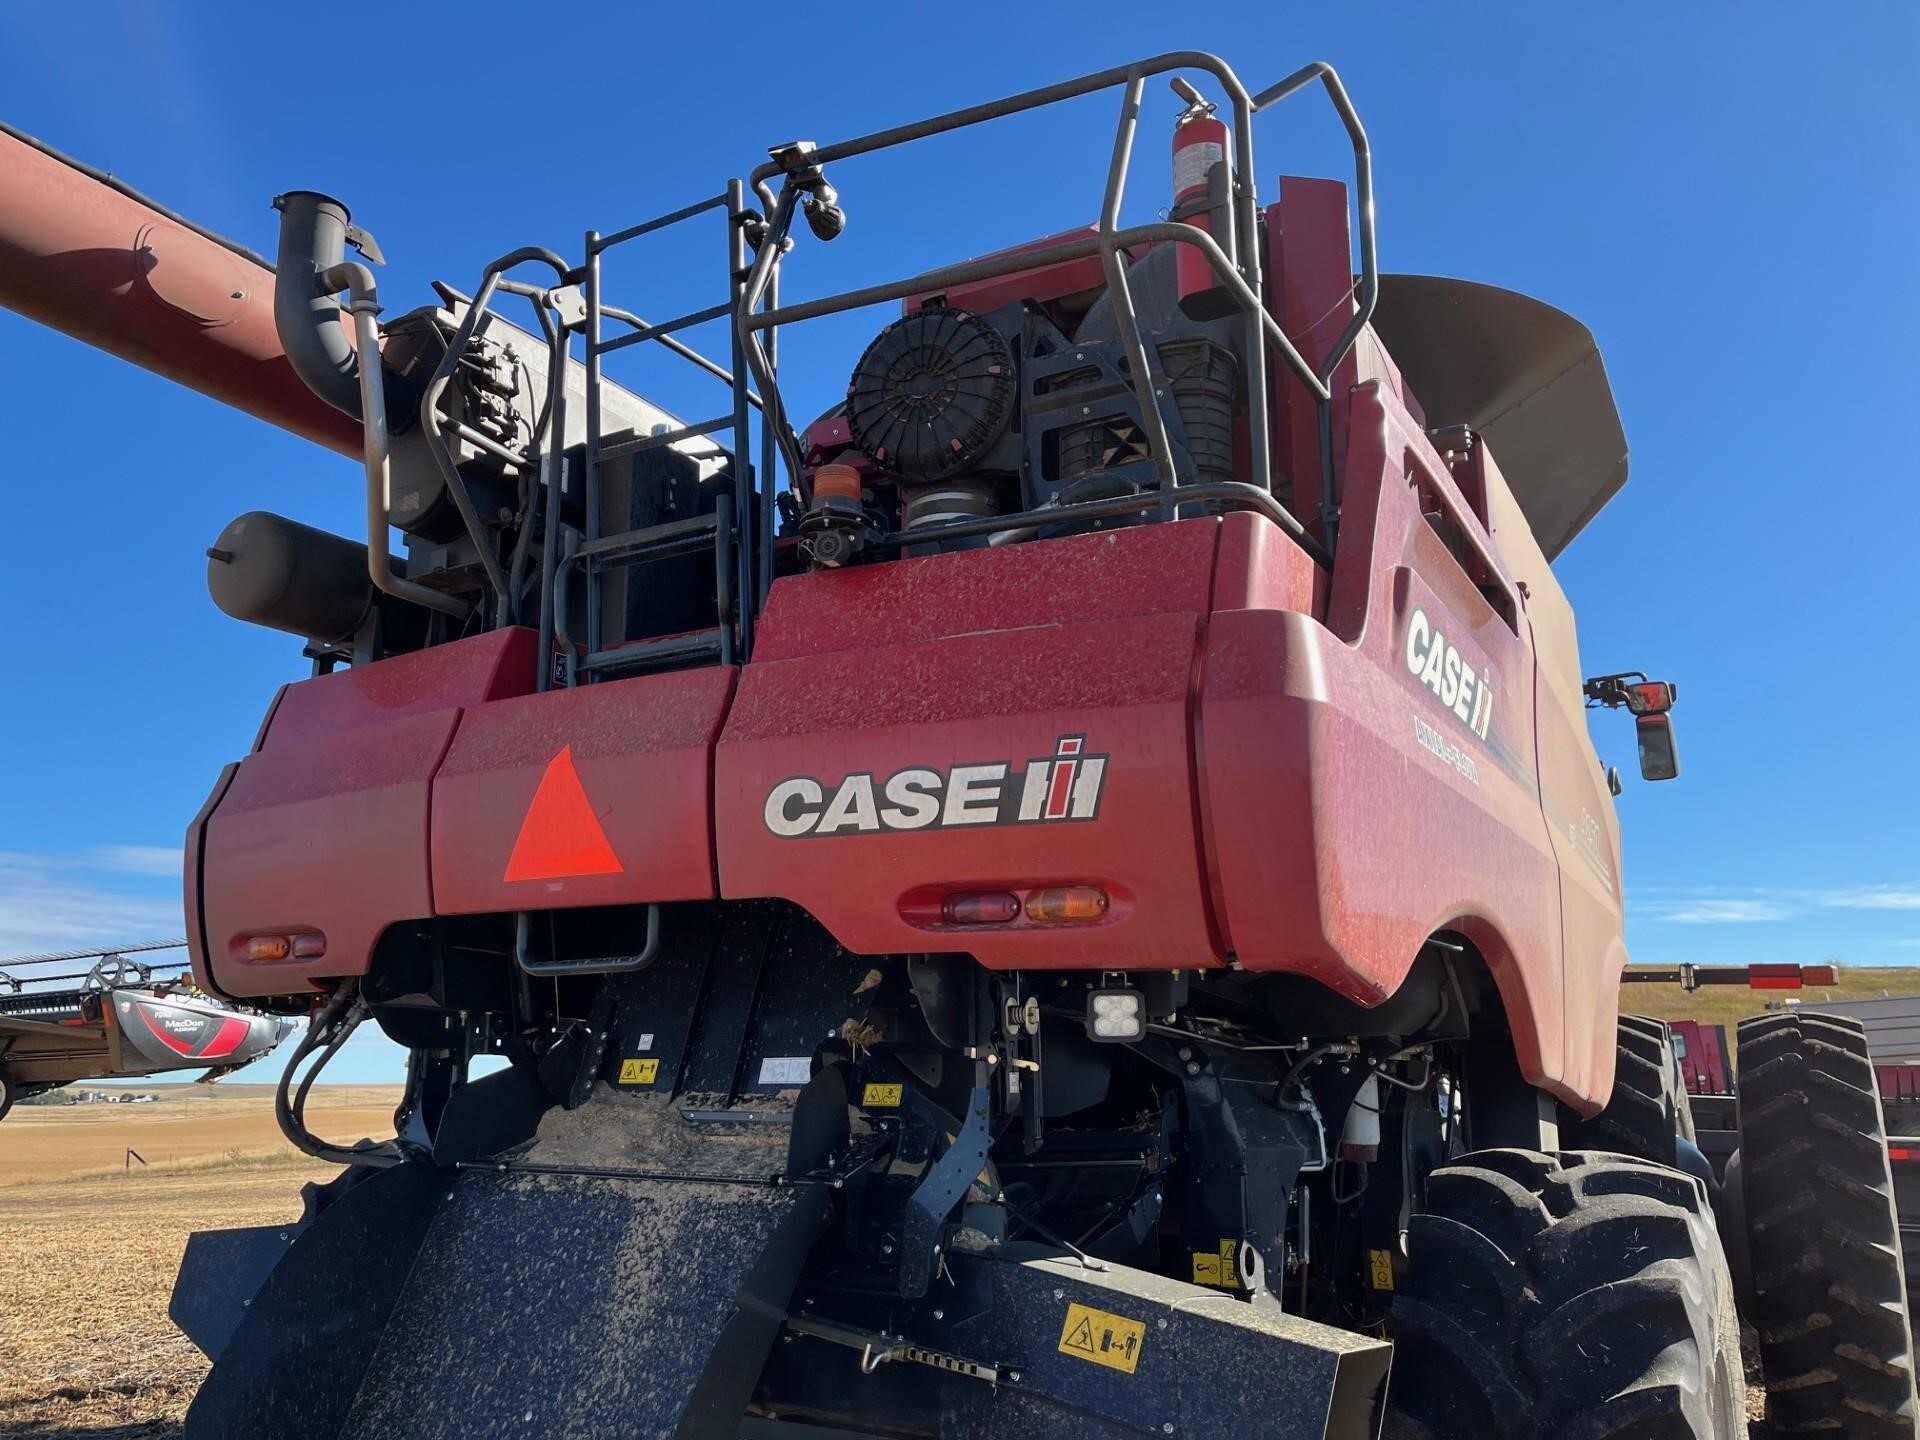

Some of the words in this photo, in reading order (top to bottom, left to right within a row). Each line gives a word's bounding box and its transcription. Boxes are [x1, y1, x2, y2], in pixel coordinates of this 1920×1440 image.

[1406, 609, 1475, 722] CASE
[764, 763, 1007, 837] CASE
[1017, 737, 1107, 819] IH
[165, 1019, 204, 1028] MacDon
